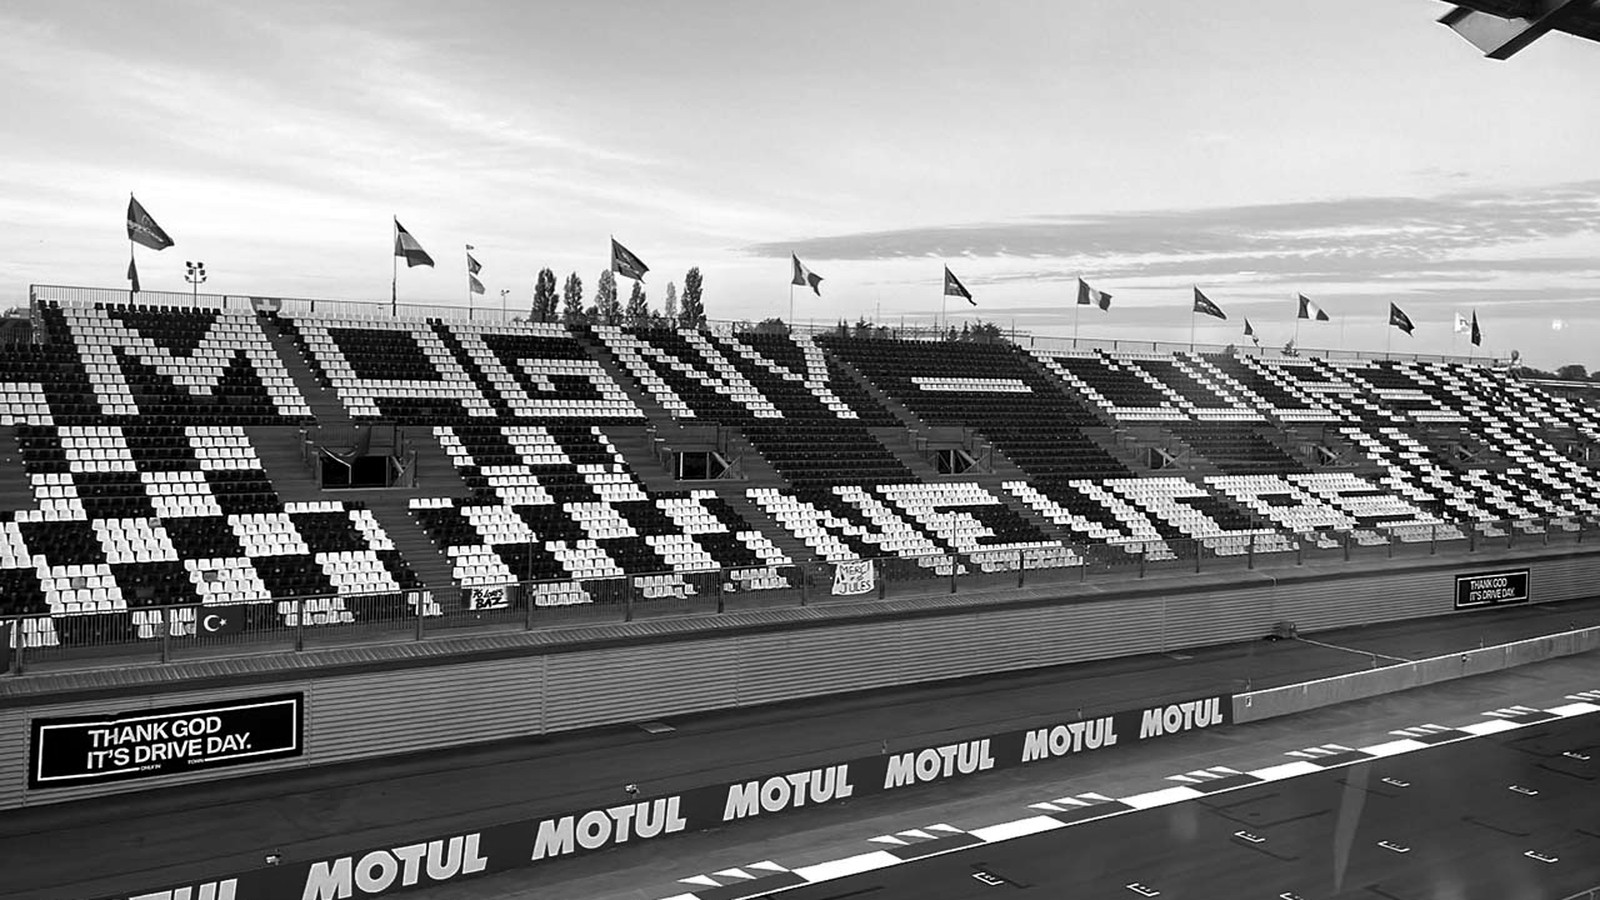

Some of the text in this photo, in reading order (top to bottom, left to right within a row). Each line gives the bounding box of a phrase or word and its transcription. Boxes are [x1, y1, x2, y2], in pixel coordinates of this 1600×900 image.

[475, 596, 510, 609] BAZ
[839, 580, 871, 594] JULES
[1470, 578, 1508, 590] THANK GOD
[1482, 588, 1502, 600] DRIVE
[88, 716, 222, 747] THANK GOD
[1139, 697, 1224, 739] MOTUL
[87, 731, 252, 769] IT'S DRIVE DAY.
[1022, 716, 1119, 763] MOTUL
[884, 738, 995, 790] MOTUL
[723, 765, 853, 822] MOTUL
[531, 795, 687, 860] MOTUL
[303, 832, 488, 900] MOTUL
